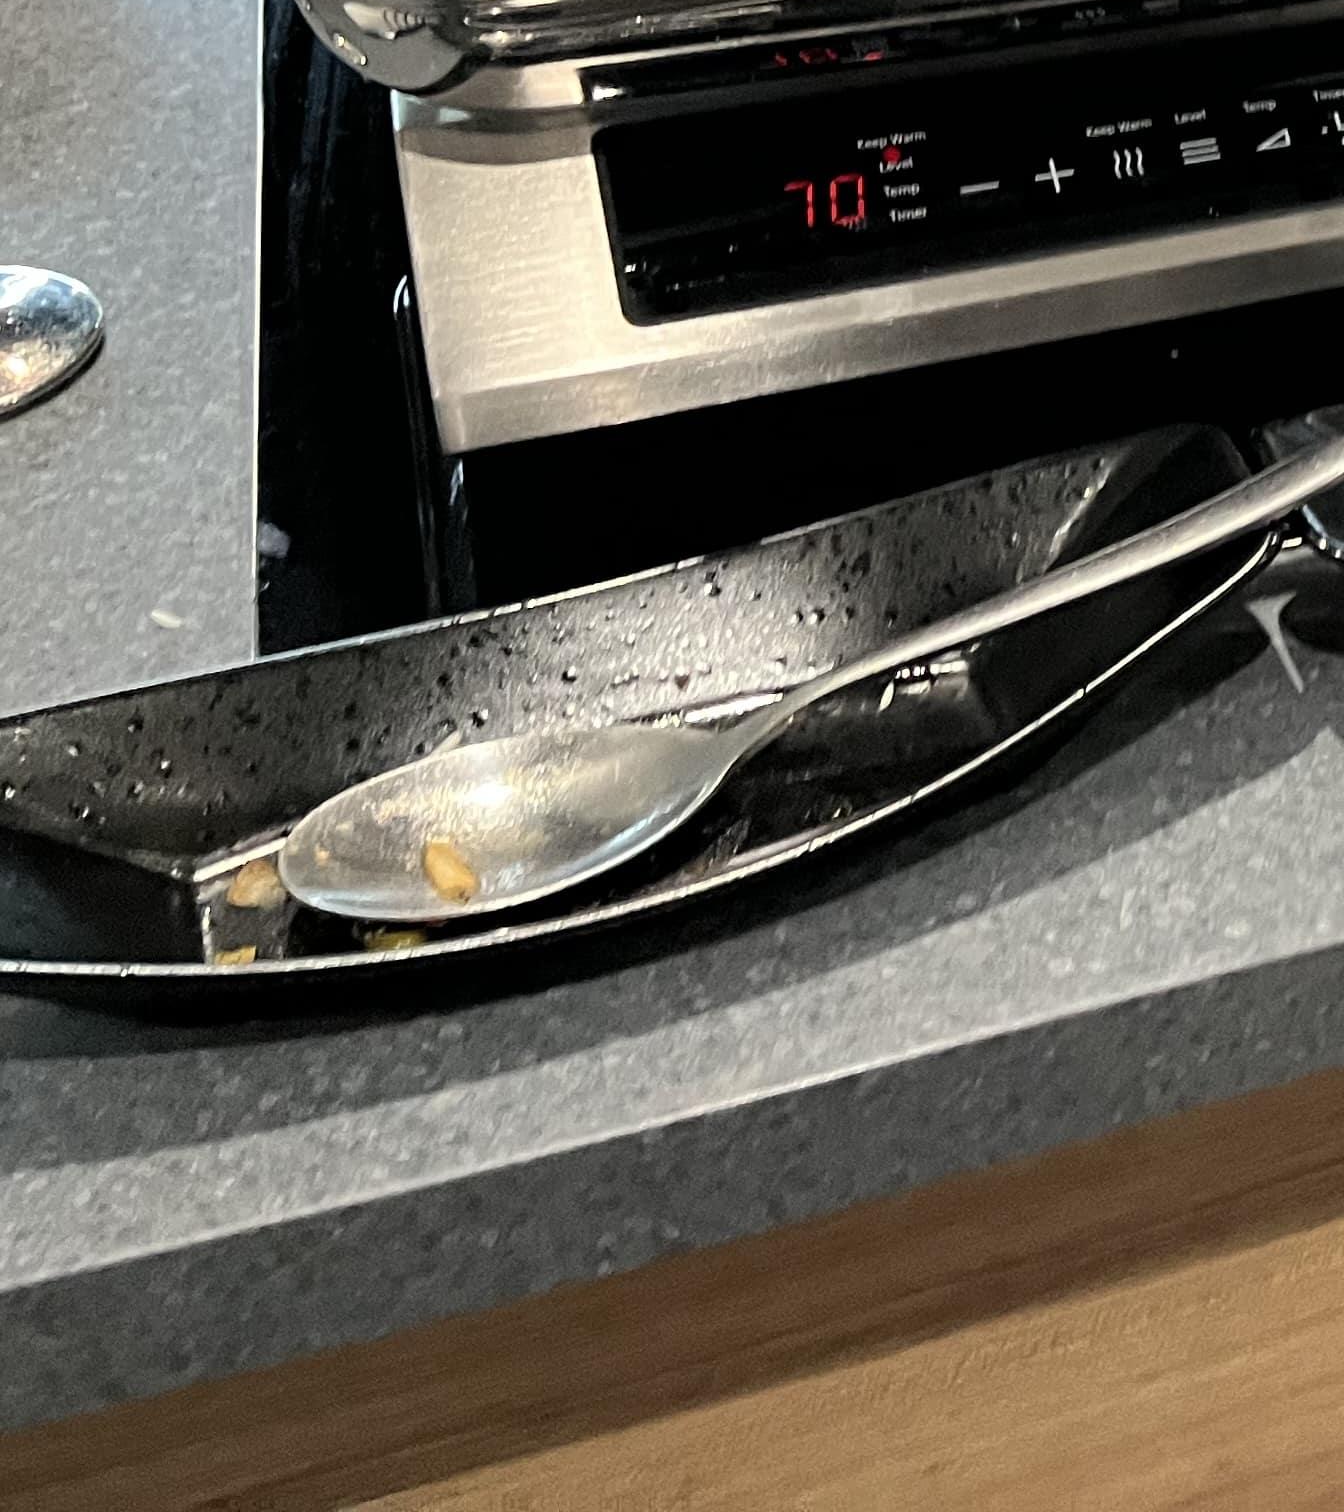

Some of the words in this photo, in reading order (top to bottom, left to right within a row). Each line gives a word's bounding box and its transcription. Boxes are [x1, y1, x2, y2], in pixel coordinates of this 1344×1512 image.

[1242, 98, 1276, 113] Temp
[1174, 108, 1206, 125] Level
[1086, 124, 1116, 137] Keep
[1117, 118, 1152, 133] Warm
[857, 136, 888, 150] Keep
[889, 131, 927, 145] Warm
[879, 156, 913, 173] Level
[884, 183, 920, 197] Temp
[783, 173, 865, 228] 70
[890, 205, 927, 222] Timer
